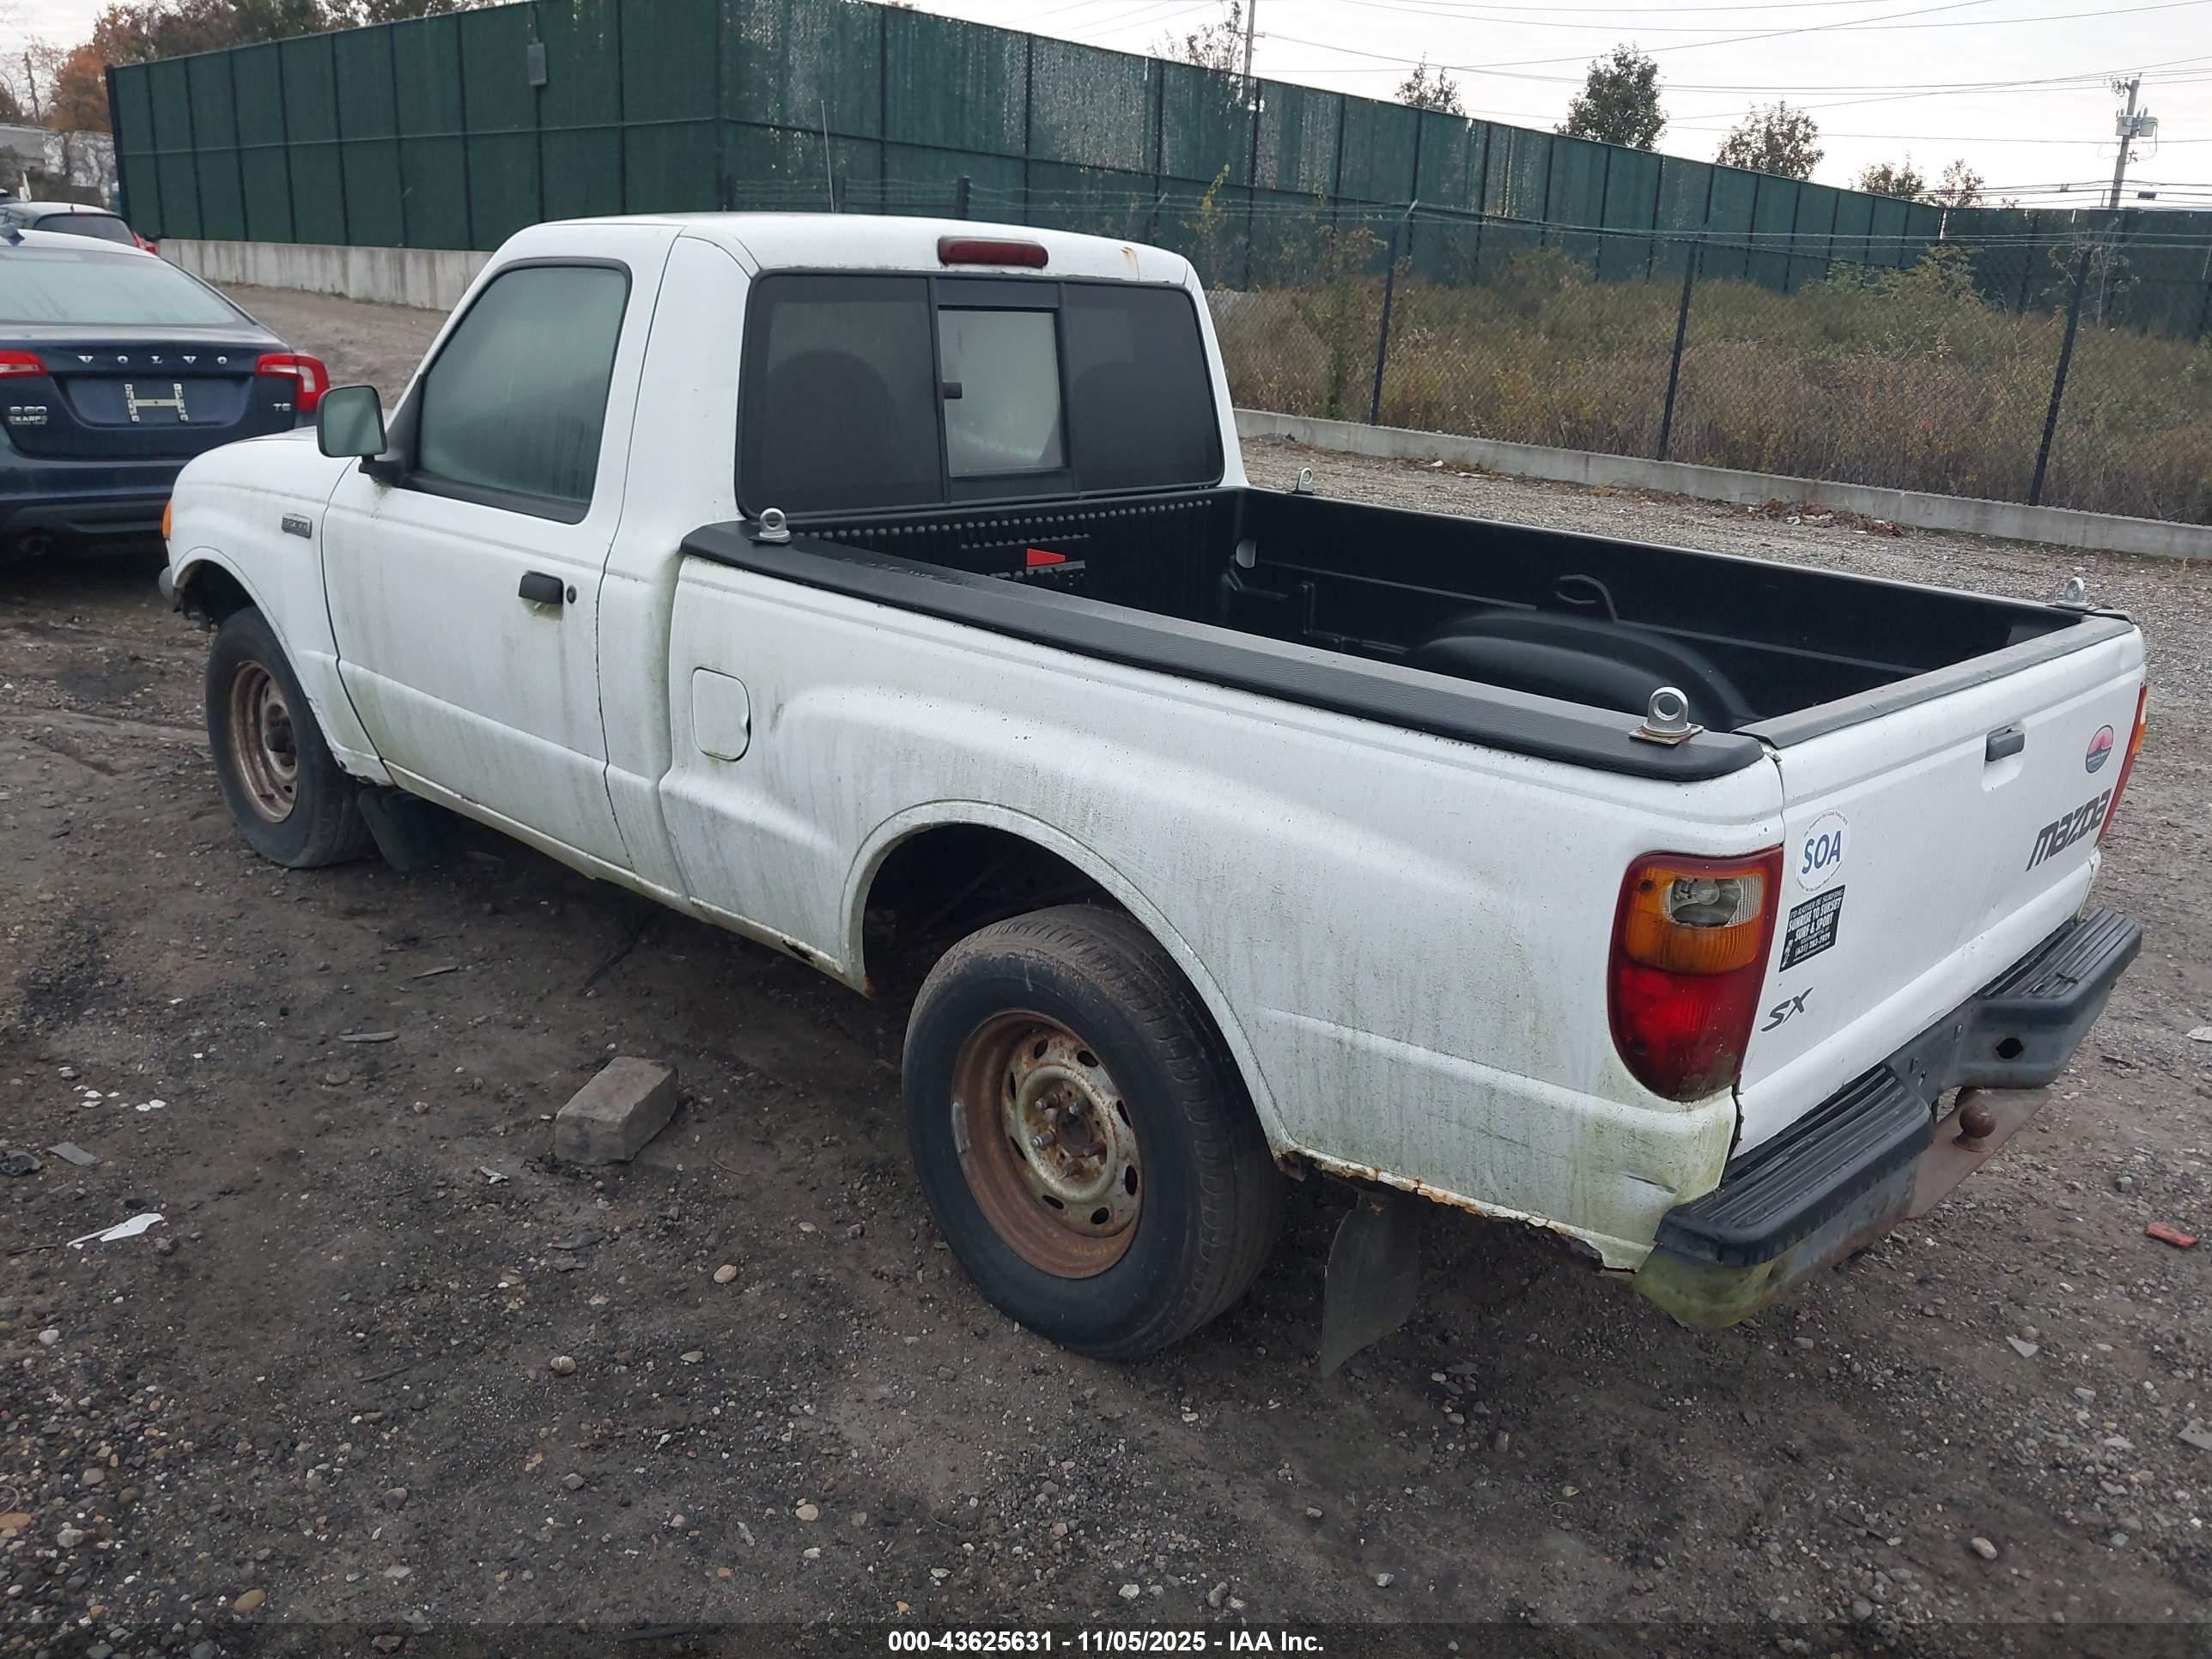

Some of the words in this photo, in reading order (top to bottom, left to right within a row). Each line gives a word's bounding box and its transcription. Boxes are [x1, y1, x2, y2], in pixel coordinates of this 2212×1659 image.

[77, 355, 228, 365] VOLVO
[1801, 830, 1842, 874] SOA
[1788, 911, 1812, 933] SUNRISE
[1813, 907, 1820, 921] TO
[1820, 897, 1842, 916] SUNSET
[1795, 924, 1810, 942] SURF
[1810, 921, 1814, 933] &
[1815, 912, 1834, 931] SPORT
[1760, 986, 1814, 1032] SX
